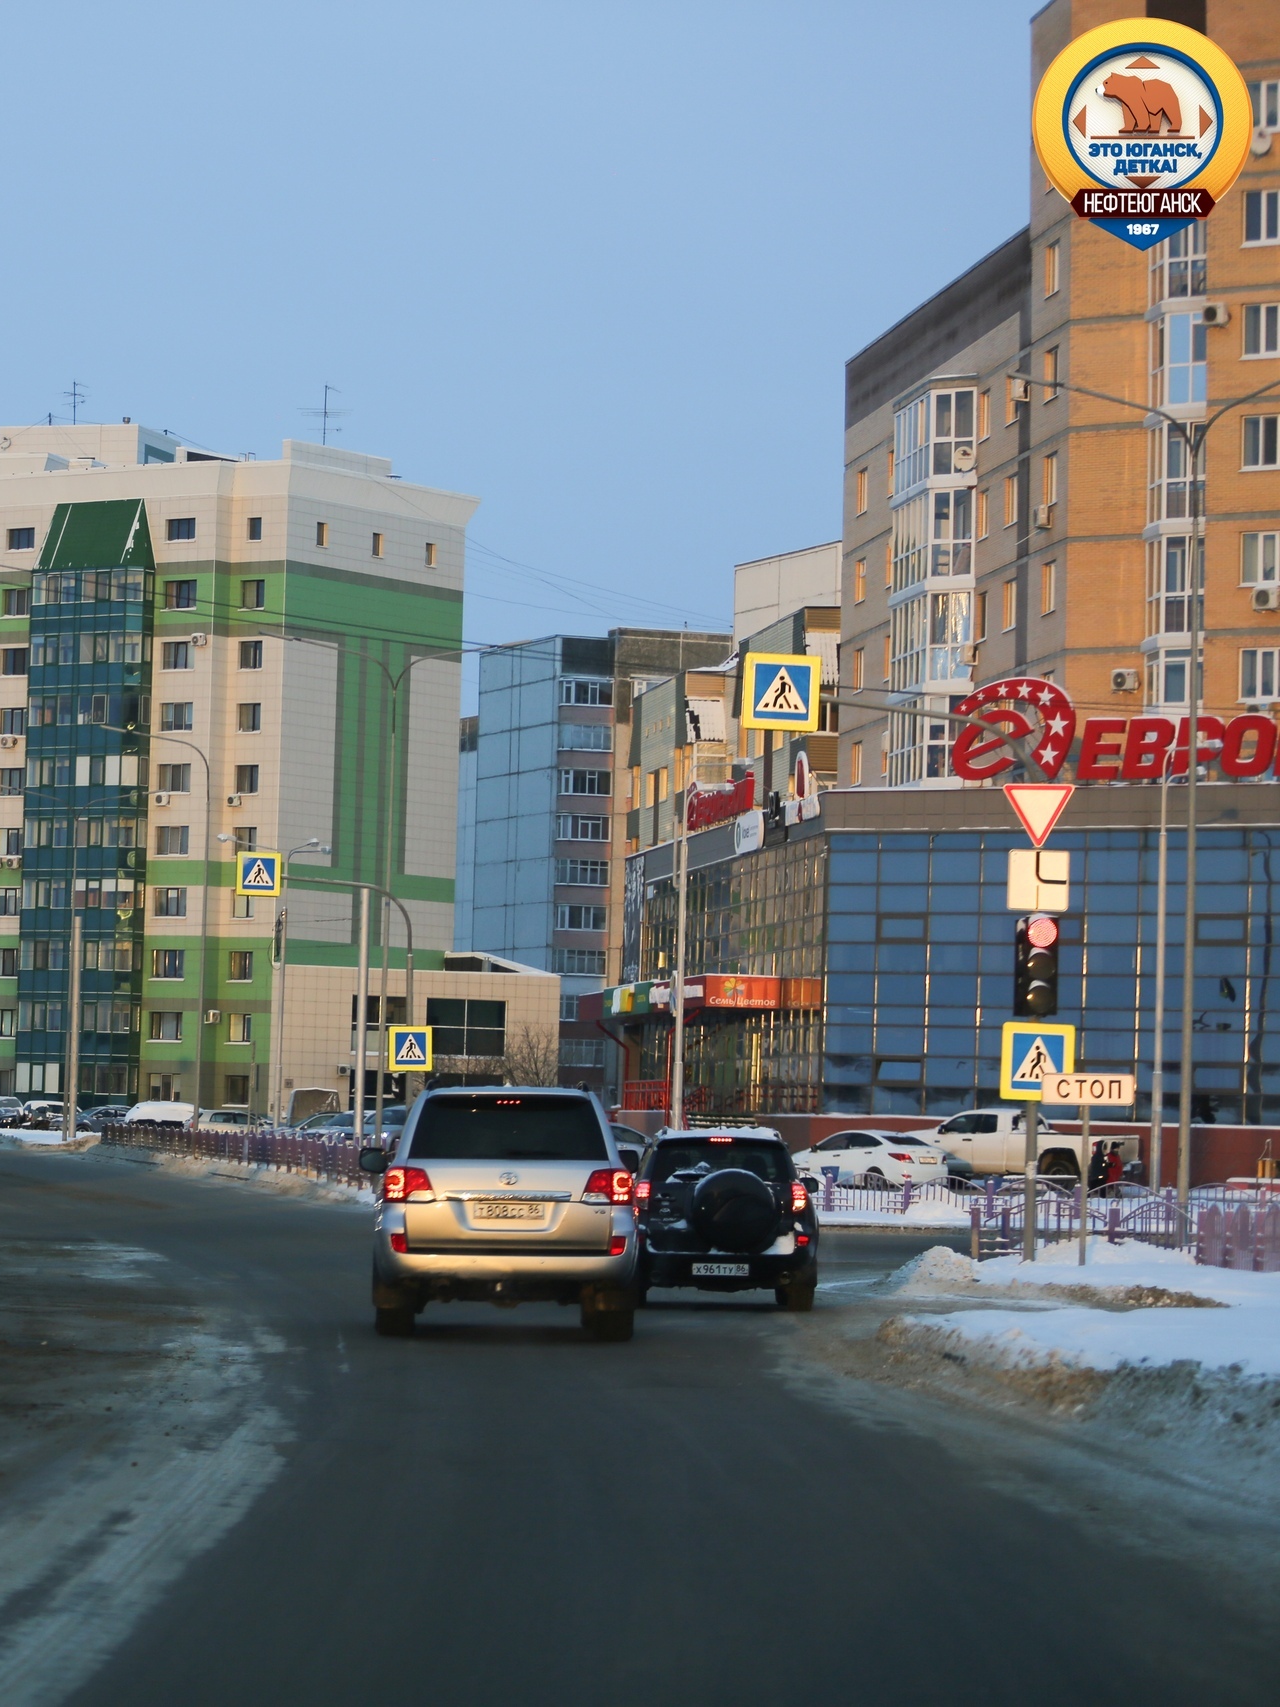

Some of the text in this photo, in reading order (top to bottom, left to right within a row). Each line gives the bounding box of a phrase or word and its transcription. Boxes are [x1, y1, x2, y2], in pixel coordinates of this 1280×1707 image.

[1076, 714, 1280, 780] ЕВРО
[709, 996, 735, 1006] Семь
[736, 997, 776, 1007] Цветов
[1056, 1079, 1122, 1099] СТОП
[736, 1264, 746, 1273] 86
